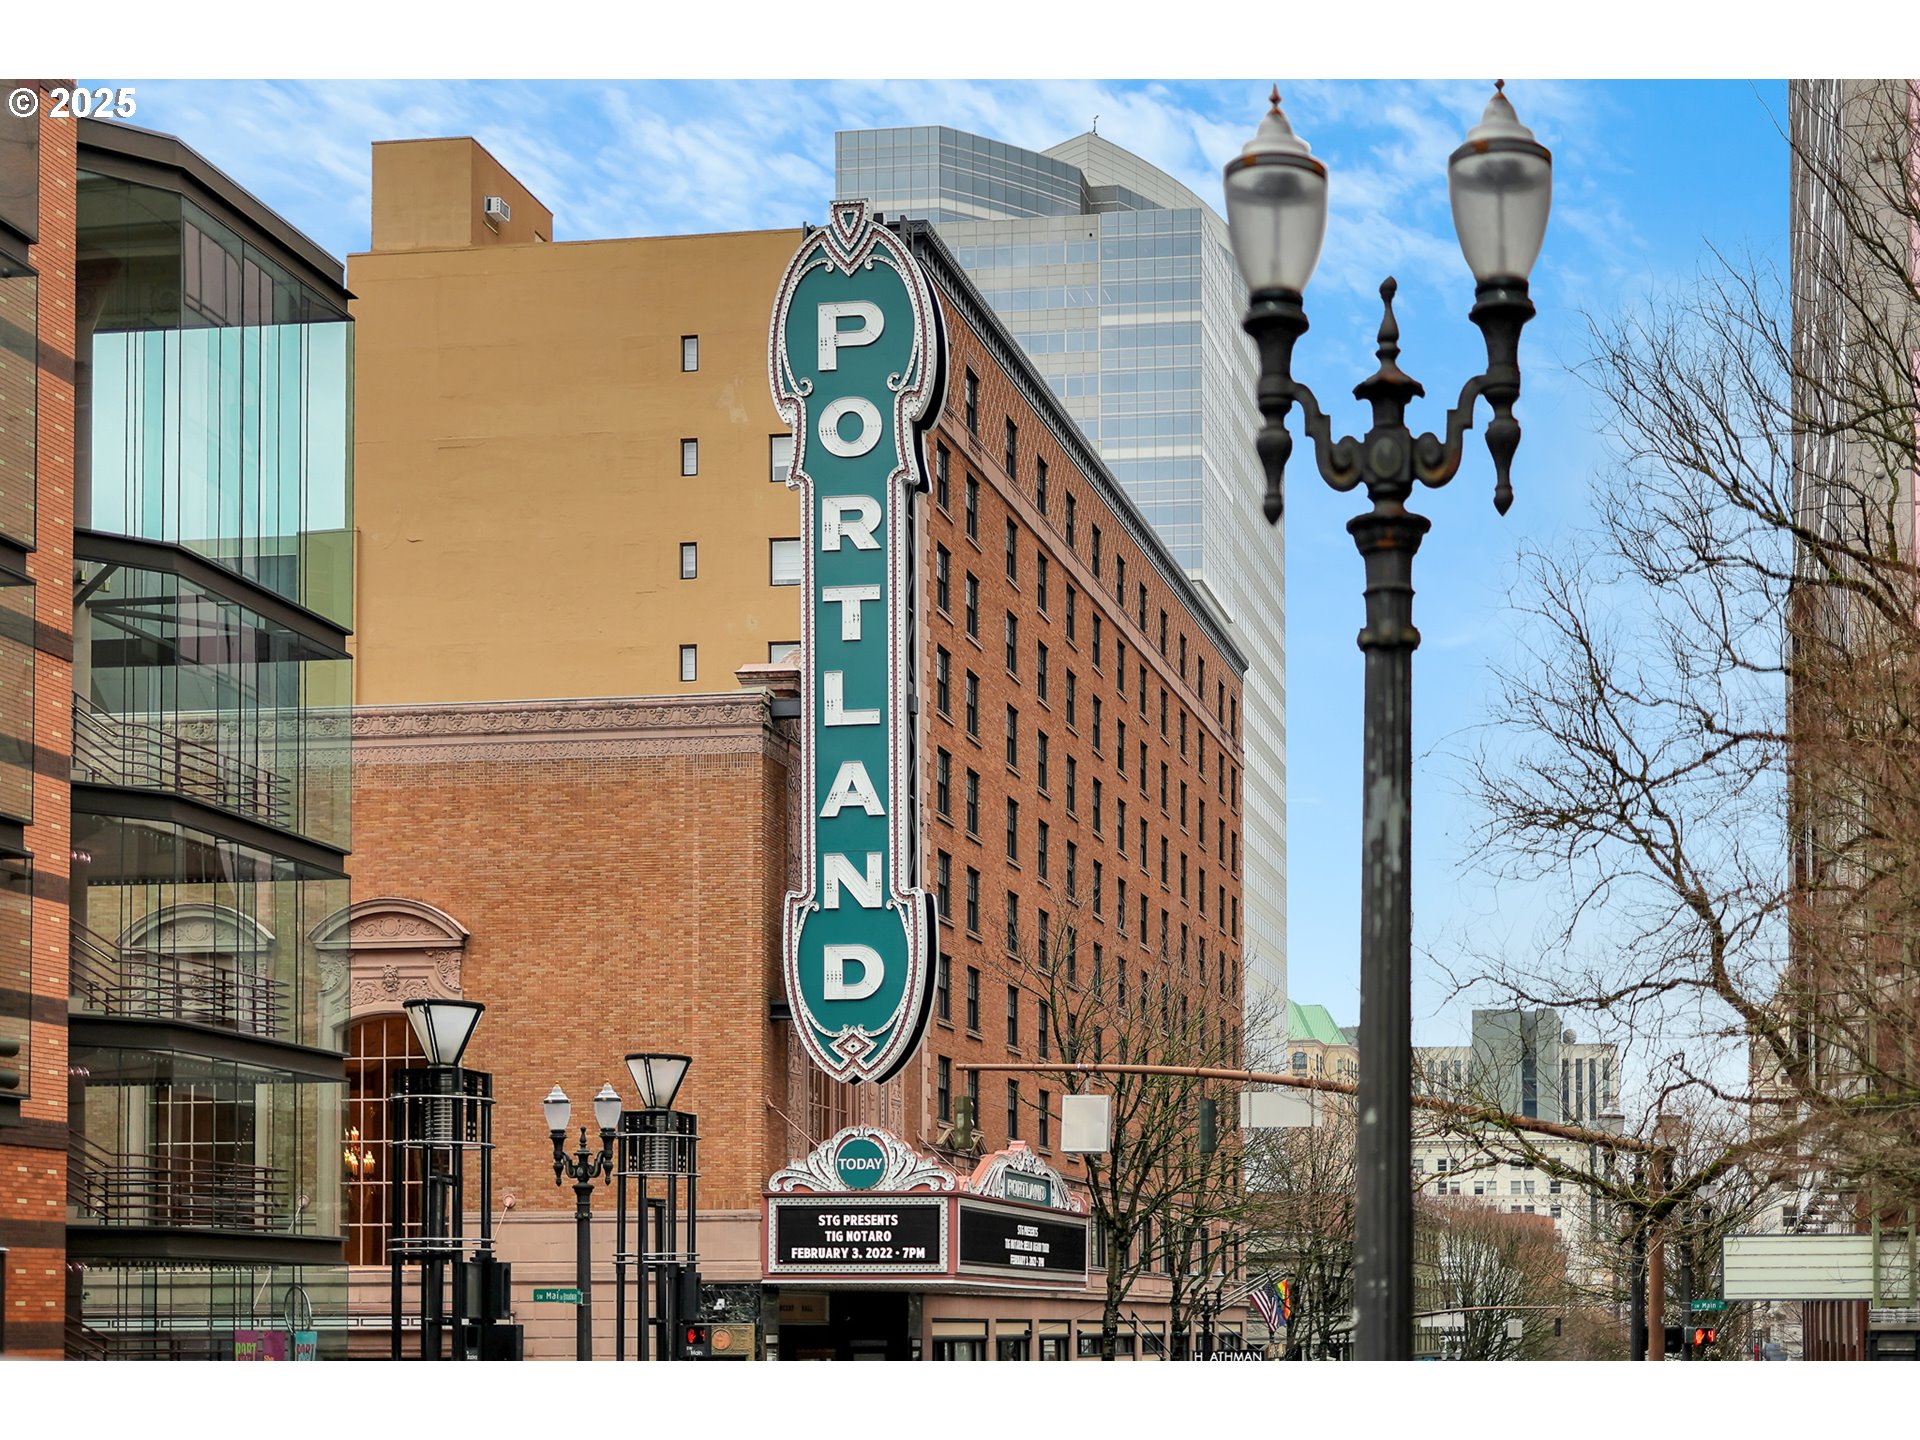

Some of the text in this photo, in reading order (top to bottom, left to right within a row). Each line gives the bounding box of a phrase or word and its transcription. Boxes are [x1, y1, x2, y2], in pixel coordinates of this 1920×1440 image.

[815, 299, 887, 1002] PORTLAND
[837, 1157, 883, 1170] TODAY
[1007, 1179, 1047, 1202] PORTLAND
[818, 1214, 899, 1226] STG PRESENTS
[825, 1230, 892, 1242] TIG NOTARO
[791, 1247, 849, 1259] FEBRUARY
[865, 1247, 893, 1259] 2022
[902, 1247, 926, 1259] 7PM
